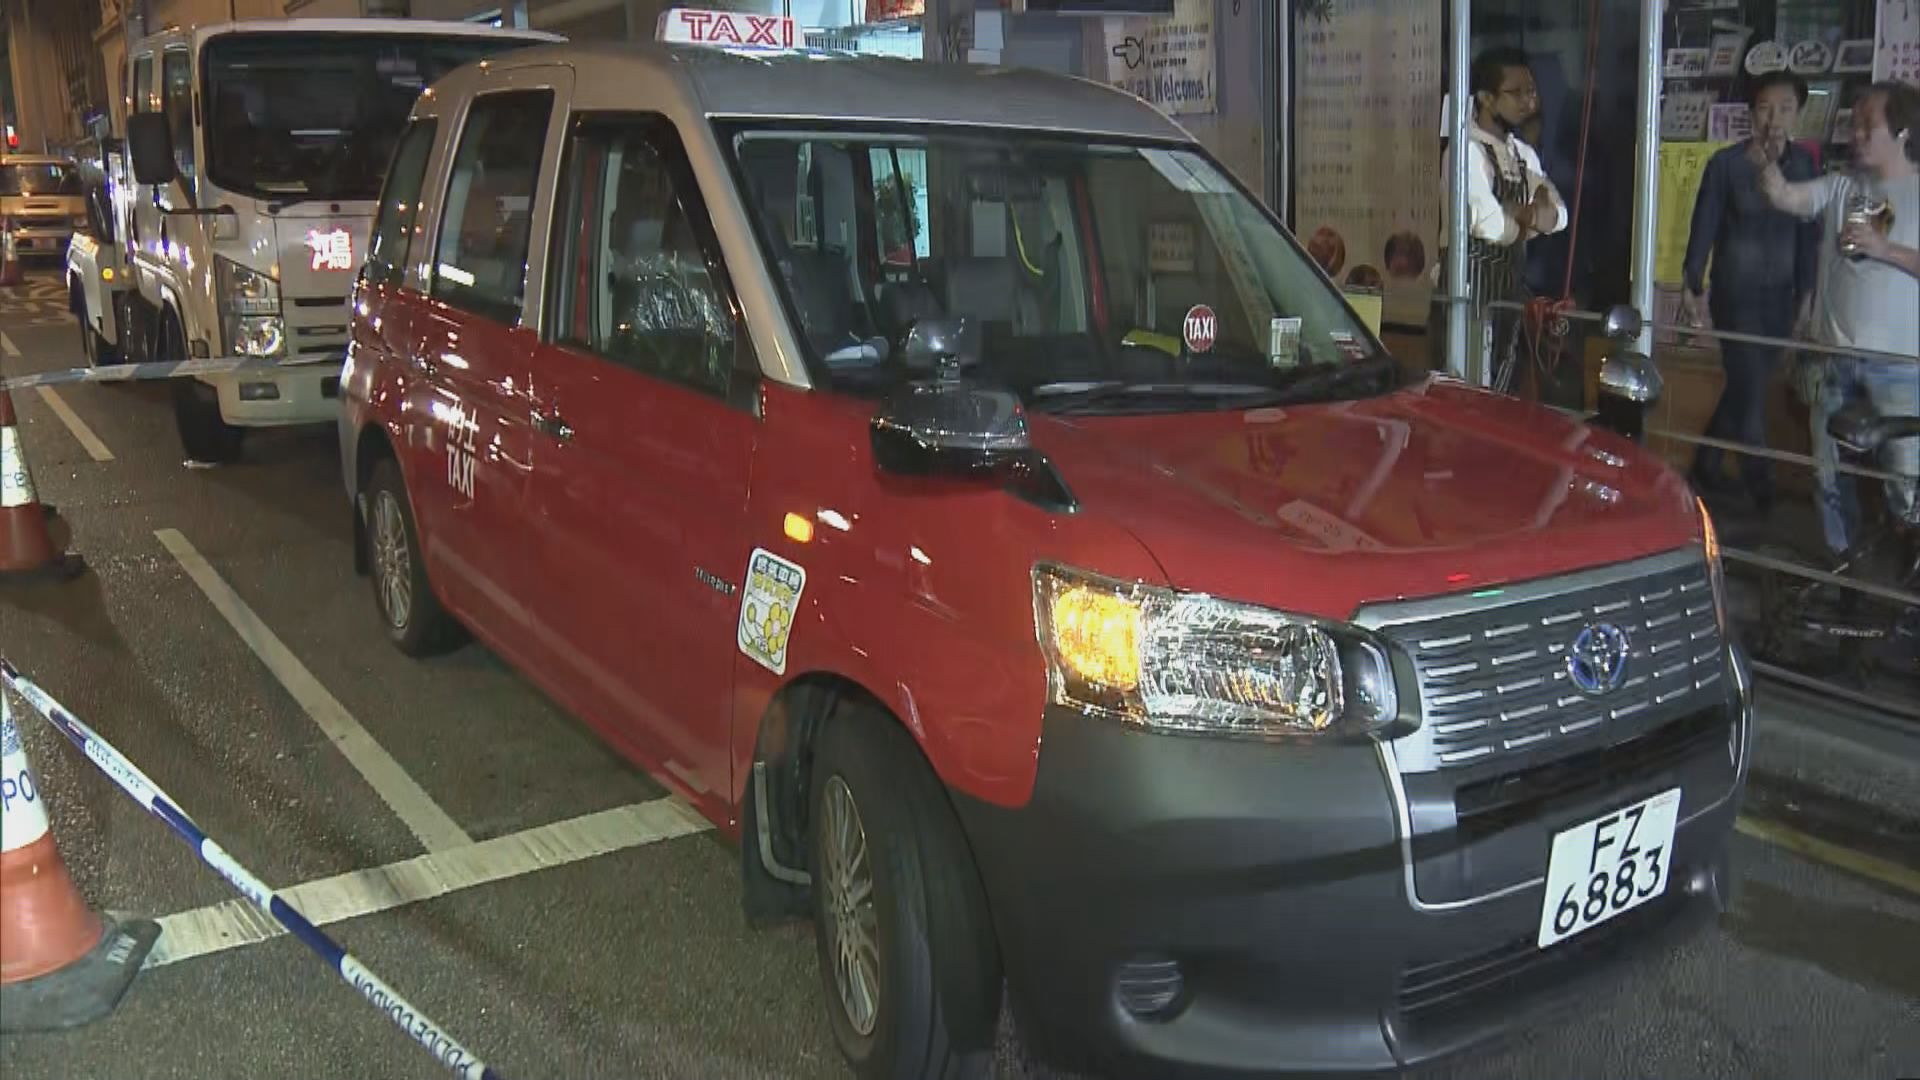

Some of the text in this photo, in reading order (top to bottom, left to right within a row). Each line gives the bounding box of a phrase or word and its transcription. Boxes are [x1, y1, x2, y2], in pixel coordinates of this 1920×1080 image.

[681, 12, 793, 48] TAXI
[1188, 317, 1214, 341] TAXI
[446, 443, 476, 500] TAXI
[1590, 804, 1646, 873] FZ
[1554, 842, 1664, 935] 6883
